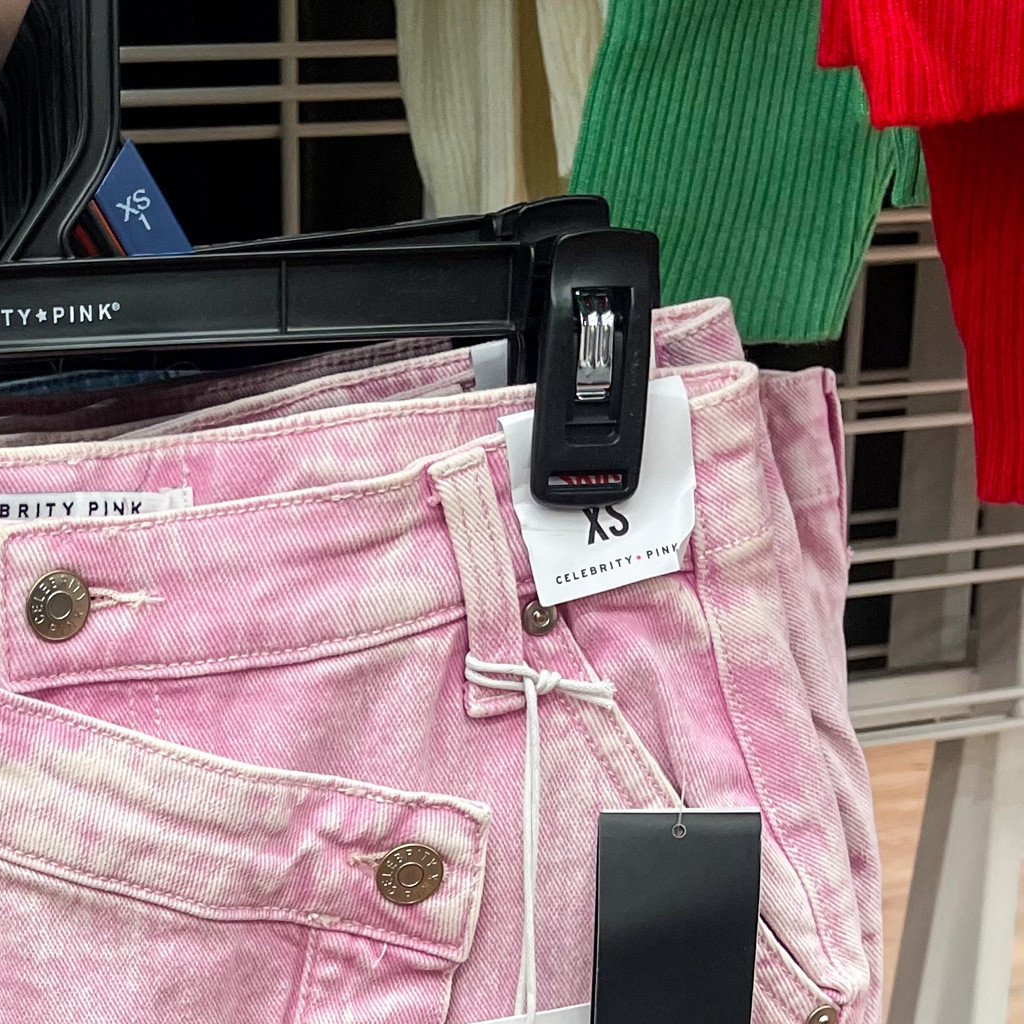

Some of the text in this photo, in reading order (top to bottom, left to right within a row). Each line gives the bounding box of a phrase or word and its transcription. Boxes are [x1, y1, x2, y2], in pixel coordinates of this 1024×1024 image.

[116, 188, 151, 222] XS
[138, 213, 151, 231] 1
[88, 501, 142, 516] PINK
[582, 505, 630, 545] XS
[556, 556, 632, 585] CELEBRITY
